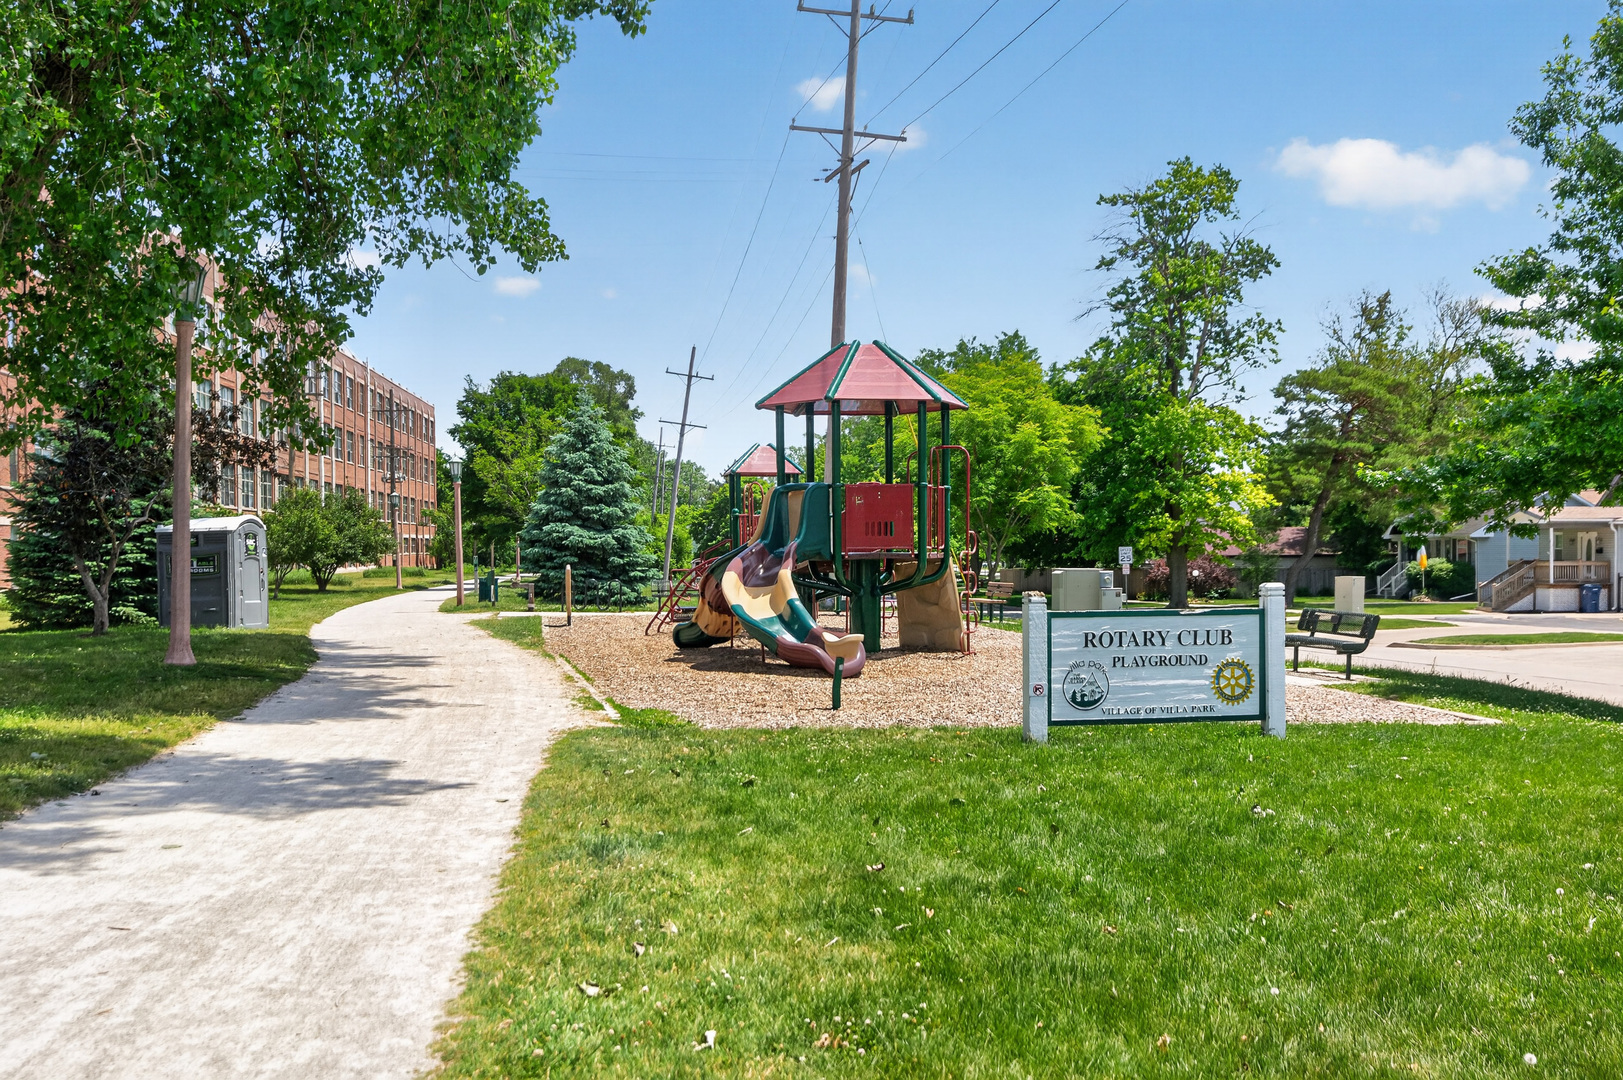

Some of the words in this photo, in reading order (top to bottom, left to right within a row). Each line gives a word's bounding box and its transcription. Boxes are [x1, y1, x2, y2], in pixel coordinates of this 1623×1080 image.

[1083, 630, 1170, 648] ROTARY
[1177, 629, 1233, 646] CLUB
[1112, 654, 1208, 668] PLAYGROUND
[1101, 707, 1143, 715] VILLAGE
[1144, 706, 1158, 714] OF
[1160, 705, 1188, 714] VILLA
[1191, 704, 1216, 713] PARK
